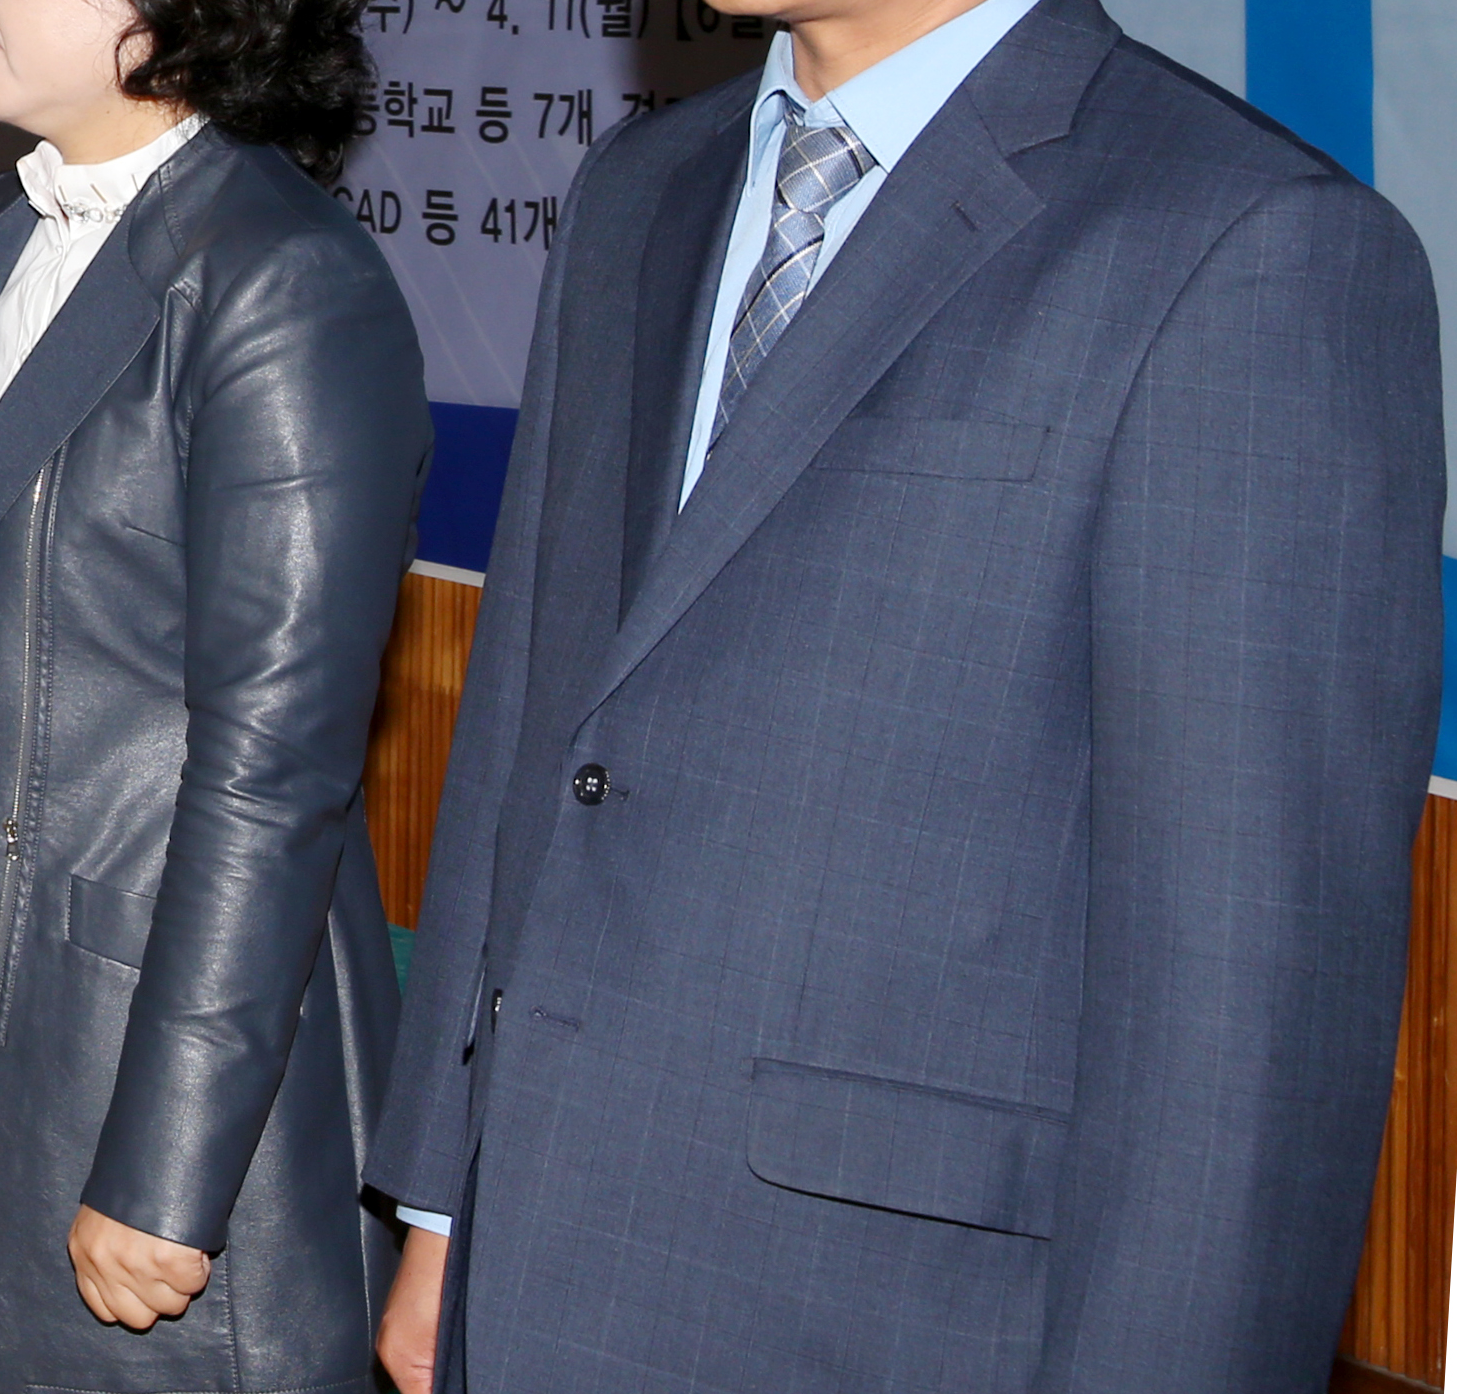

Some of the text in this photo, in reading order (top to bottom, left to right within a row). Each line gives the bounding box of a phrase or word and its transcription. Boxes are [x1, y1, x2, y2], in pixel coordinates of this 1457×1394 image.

[476, 86, 512, 144] 등
[533, 89, 592, 147] 7개
[422, 190, 459, 246] 등
[480, 196, 557, 251] 41개
